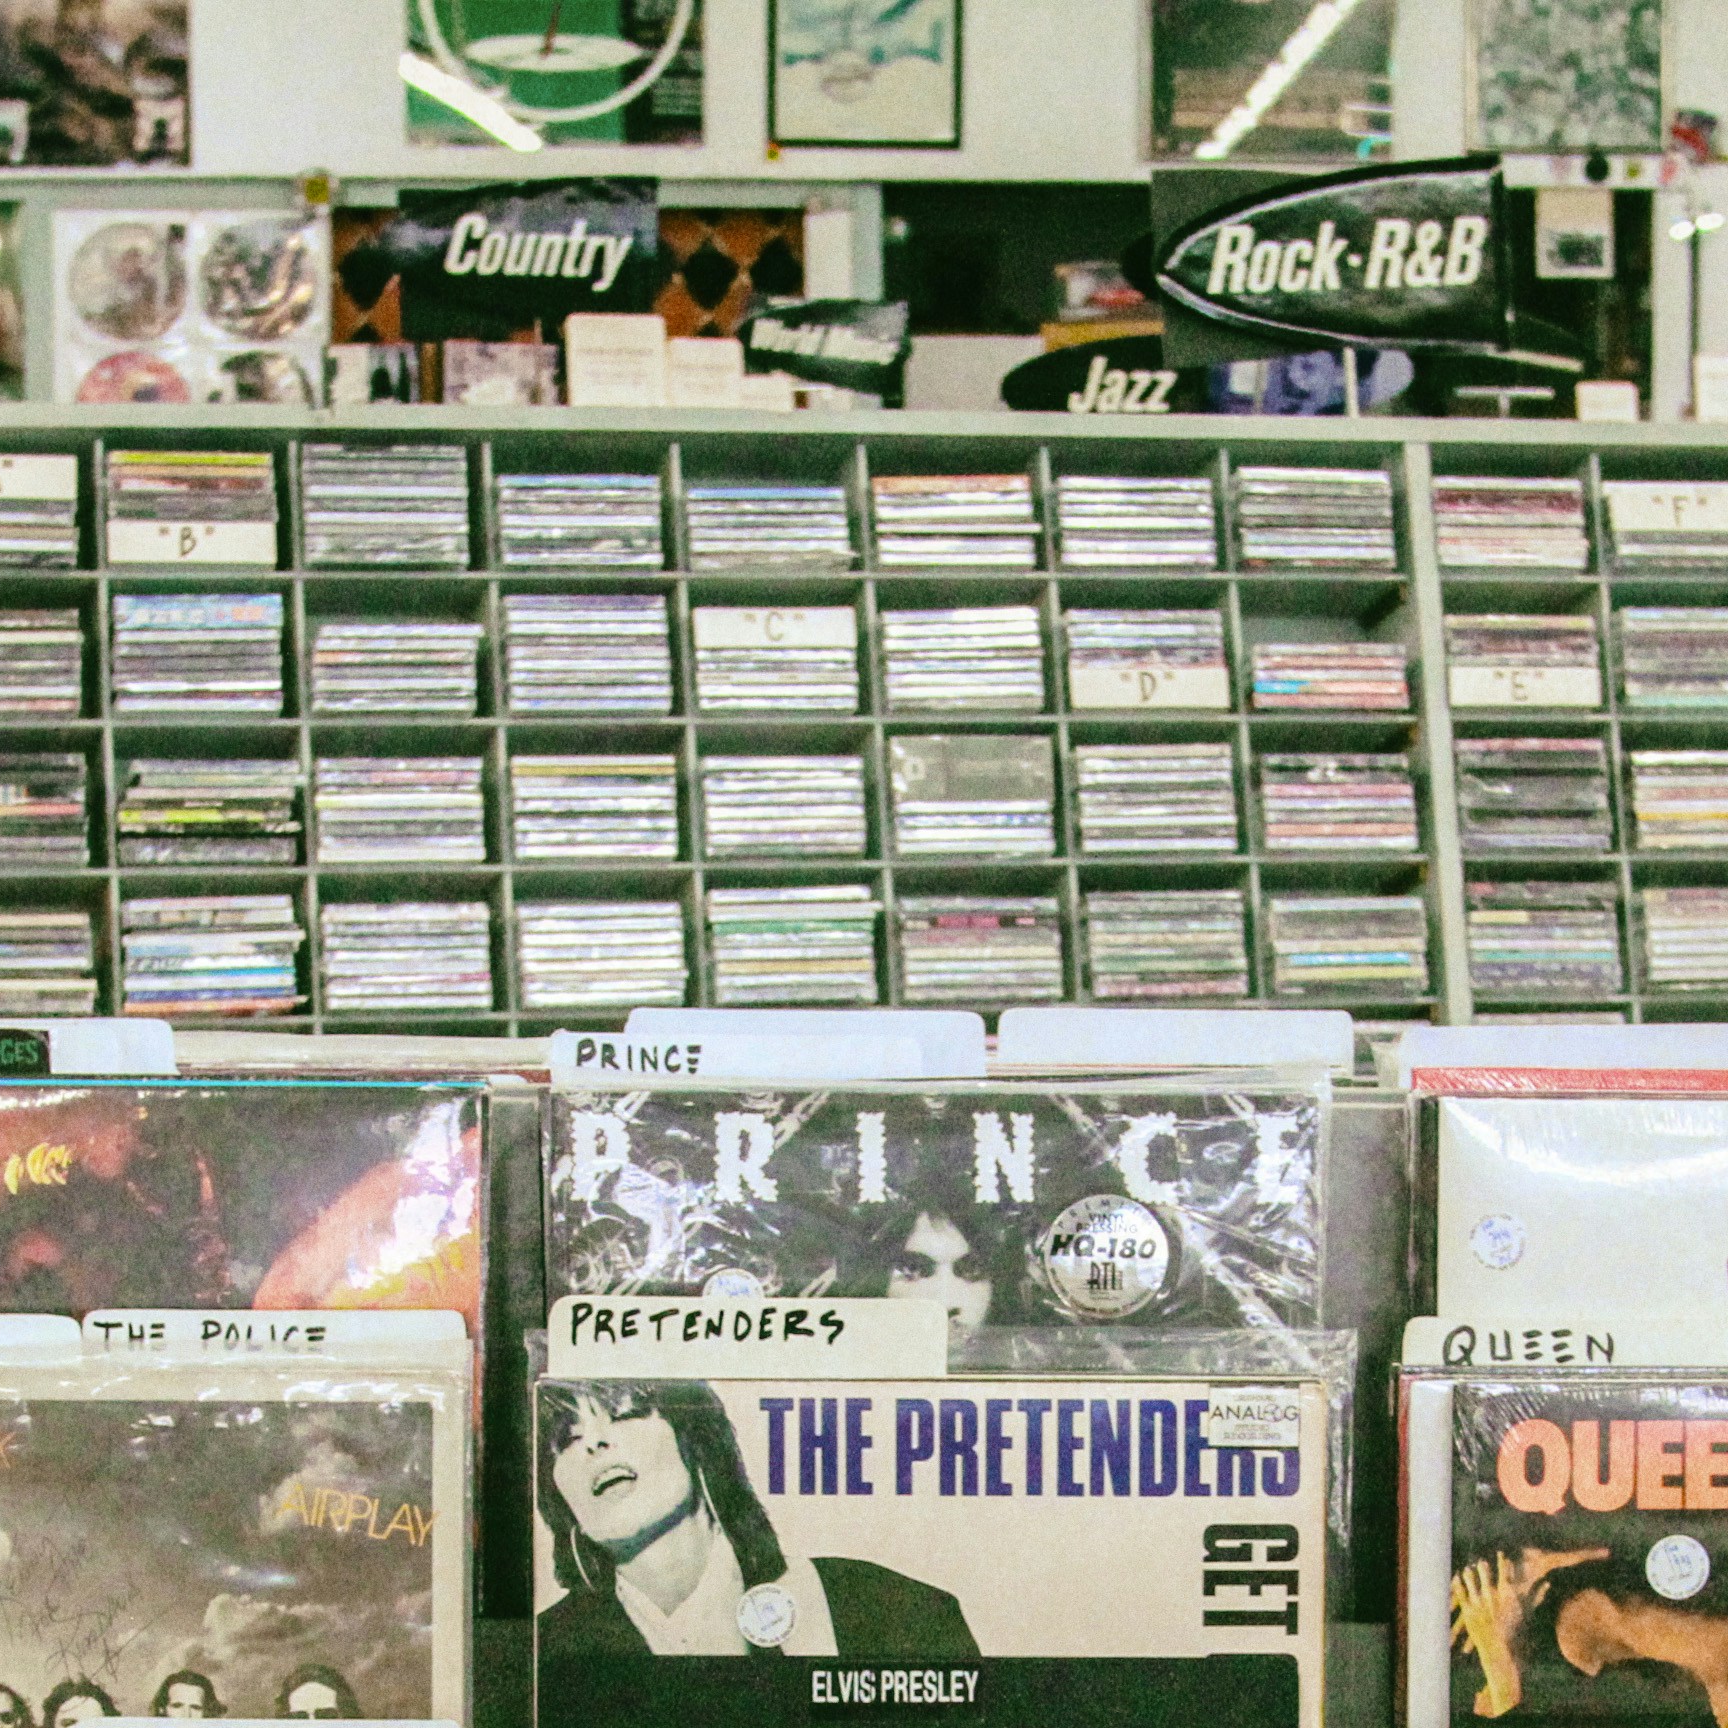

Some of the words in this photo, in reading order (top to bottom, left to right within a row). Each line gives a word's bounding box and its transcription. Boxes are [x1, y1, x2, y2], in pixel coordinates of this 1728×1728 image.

[444, 212, 633, 292] Country
[1068, 355, 1177, 413] Jazz
[575, 1038, 702, 1075] PRINCE
[570, 1109, 1316, 1205] PRINCE
[1050, 1234, 1156, 1258] HQ-180
[93, 1321, 167, 1350] THE
[200, 1323, 328, 1352] POLICE
[570, 1306, 845, 1345] PRETENDERS
[1442, 1328, 1616, 1367] QUEEN
[759, 1397, 874, 1497] THE
[281, 1481, 441, 1548] AIRPLAY
[1202, 1523, 1300, 1636] GET
[811, 1670, 876, 1703] ELVIS
[881, 1670, 979, 1705] PRESLEY
